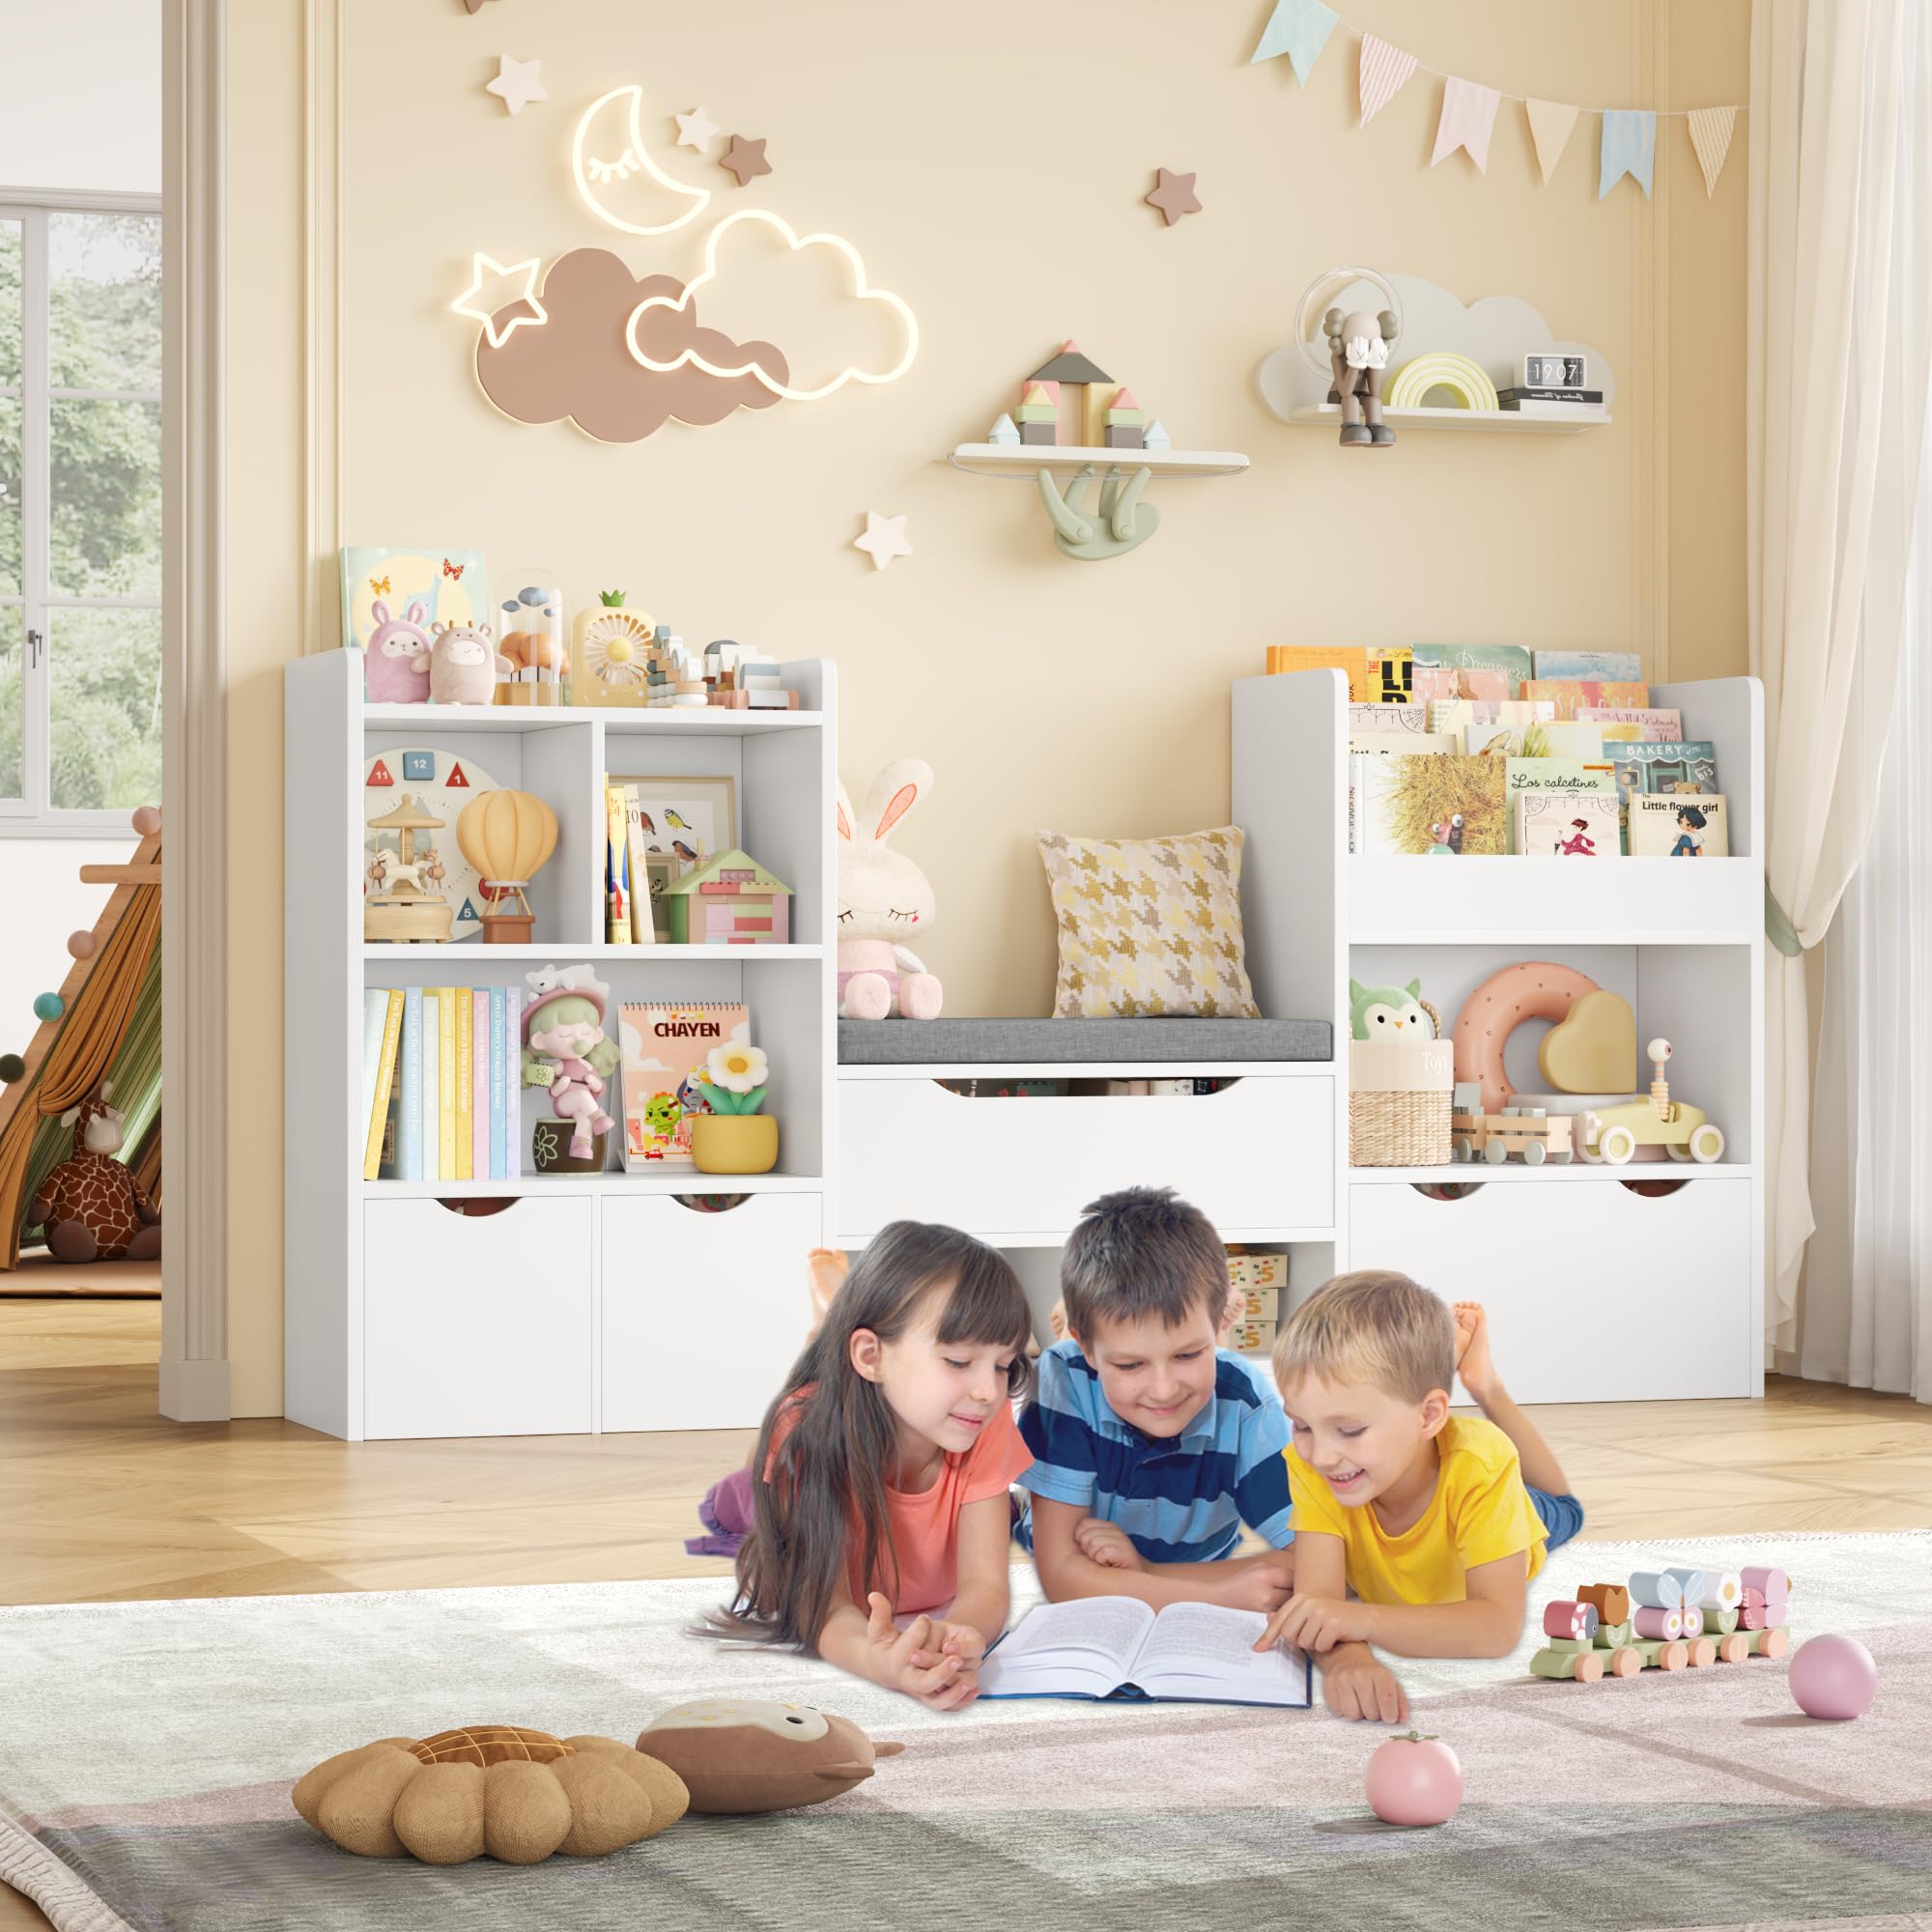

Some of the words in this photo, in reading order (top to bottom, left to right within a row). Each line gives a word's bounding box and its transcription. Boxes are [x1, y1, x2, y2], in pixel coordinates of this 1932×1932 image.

[1534, 363, 1577, 381] 1907
[1455, 649, 1527, 681] Dreamers
[1626, 745, 1683, 756] BAKERY
[412, 759, 427, 769] 12
[376, 771, 387, 780] 11
[454, 775, 461, 784] 1
[1511, 774, 1541, 788] Los
[1545, 776, 1599, 788] calcetines
[1642, 802, 1666, 810] Little
[1669, 802, 1700, 811] flower
[1702, 803, 1719, 813] girl
[464, 908, 471, 918] 5
[654, 1022, 721, 1037] CHAYEN
[1421, 1051, 1448, 1075] Toys
[1262, 1266, 1274, 1283] 5
[1246, 1298, 1262, 1315] 5
[1245, 1331, 1261, 1349] 5
